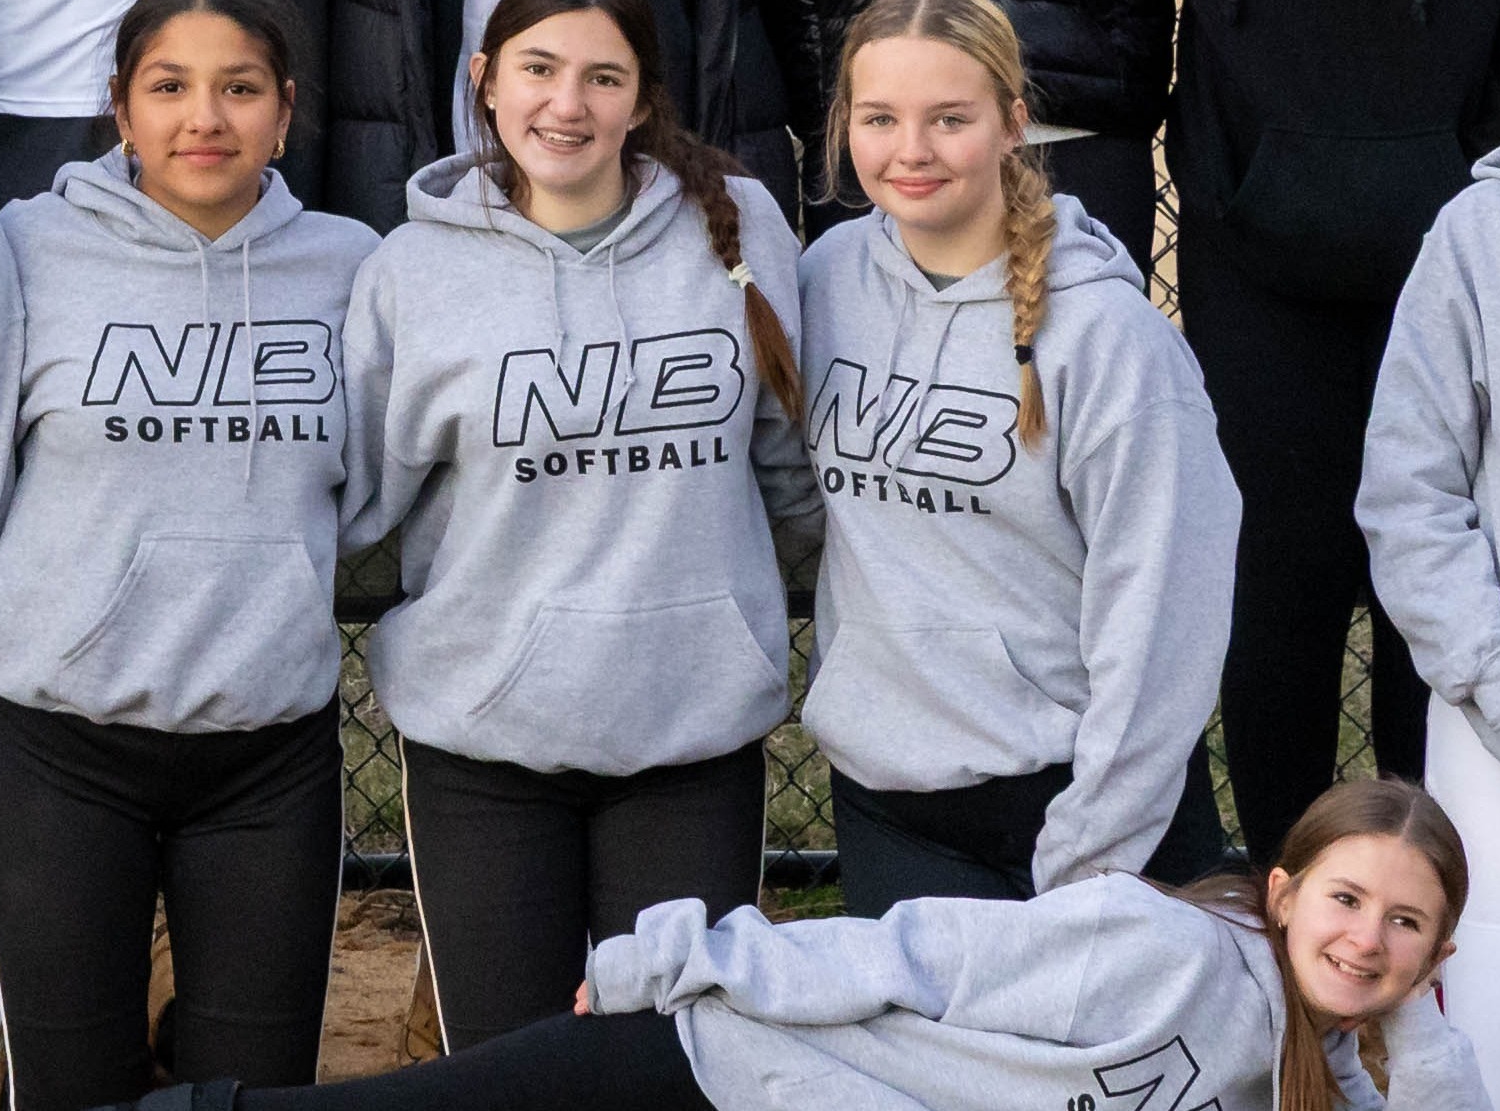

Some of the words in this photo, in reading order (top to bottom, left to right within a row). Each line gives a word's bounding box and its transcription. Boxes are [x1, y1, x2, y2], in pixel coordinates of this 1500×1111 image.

[82, 319, 337, 407] NB
[493, 327, 744, 448] NB
[105, 415, 329, 442] SOFTBALL
[515, 436, 729, 483] SOFTBALL
[808, 357, 1020, 486] NB
